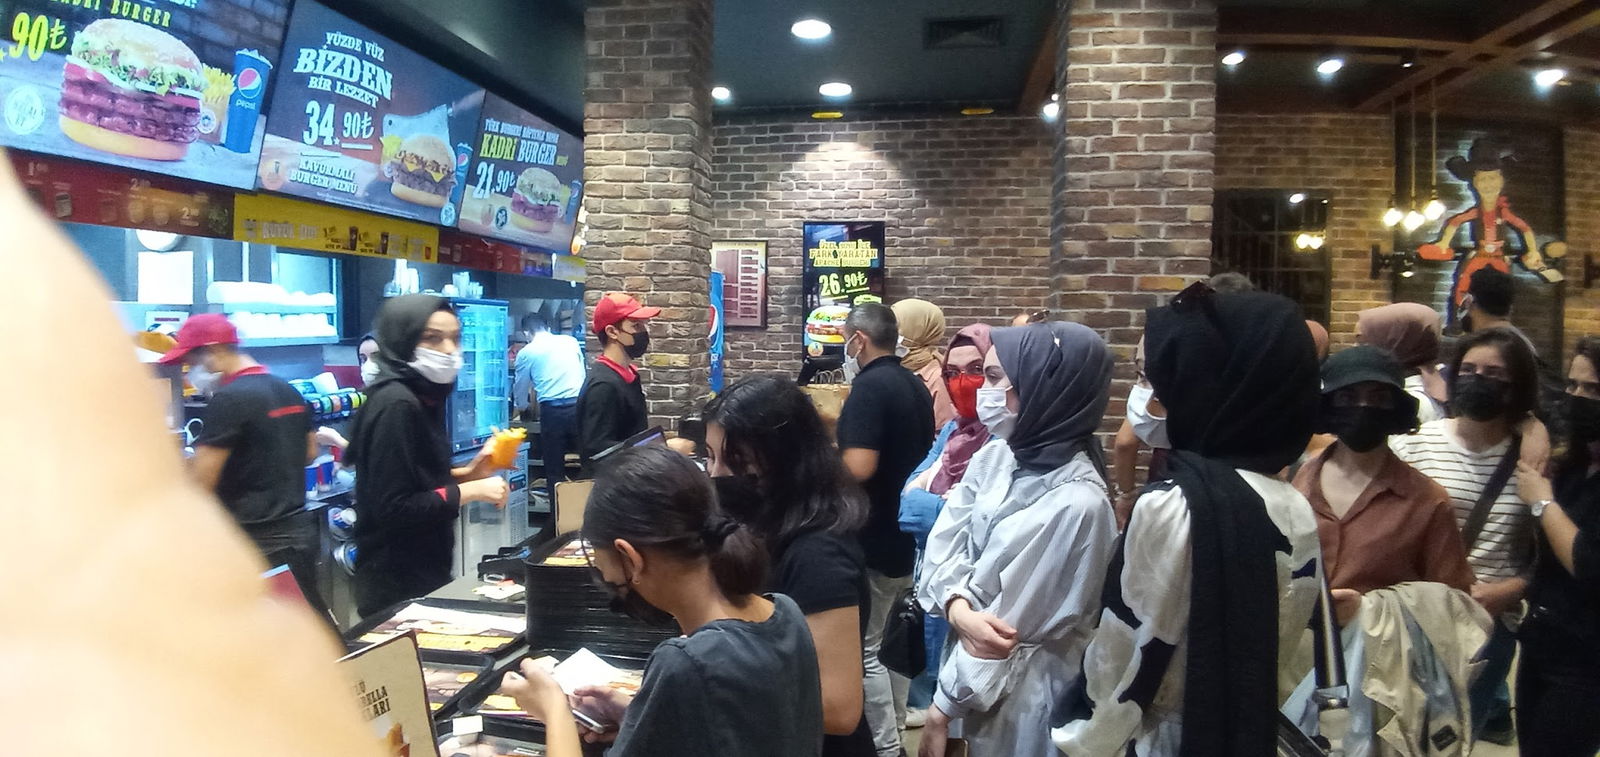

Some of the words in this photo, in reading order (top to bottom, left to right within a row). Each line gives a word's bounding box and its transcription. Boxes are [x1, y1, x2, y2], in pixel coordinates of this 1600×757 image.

[111, 0, 171, 27] BURGER
[326, 31, 362, 52] YÜZDE
[365, 41, 385, 62] YÜZ
[293, 45, 393, 100] BİZDEN
[308, 75, 332, 92] BİR
[335, 81, 379, 108] LEZZET
[517, 140, 557, 166] BURGER
[288, 169, 331, 188] BURGER
[359, 686, 388, 708] RELLA
